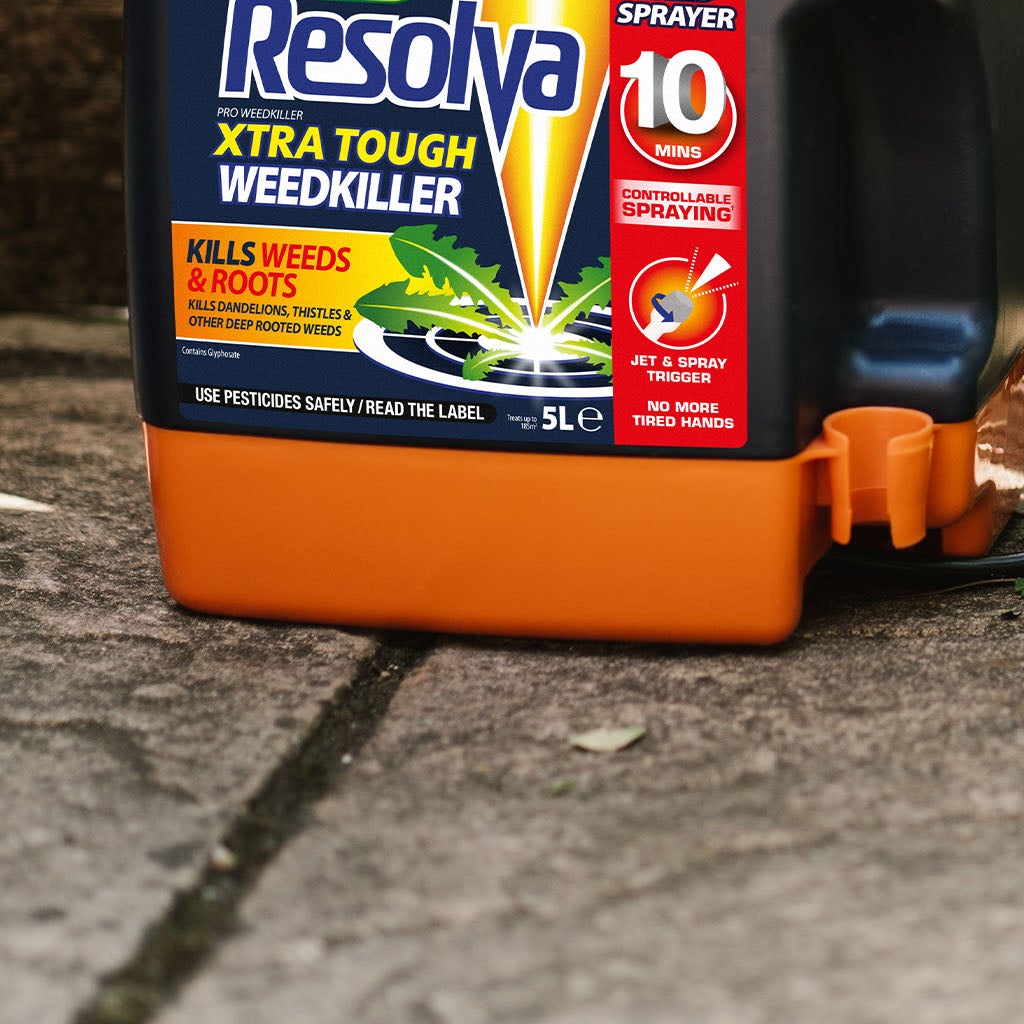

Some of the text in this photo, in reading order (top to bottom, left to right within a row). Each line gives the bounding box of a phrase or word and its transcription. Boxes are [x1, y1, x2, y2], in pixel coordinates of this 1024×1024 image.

[617, 3, 737, 29] SPRAYER
[620, 49, 727, 135] 10
[217, 107, 304, 121] PRO WEEDKILLER
[213, 123, 477, 170] XTRA TOUGH
[655, 143, 702, 159] MINS
[219, 164, 463, 216] WEEDKILLER
[622, 188, 732, 205] CONTROLLABLE
[186, 238, 351, 273] KILLS WEEDS
[187, 267, 298, 299] & ROOTS
[188, 299, 352, 321] KILLS DANDELIONS, THISTLES &
[188, 315, 342, 337] OTHER DEEP ROOTED WEEDS
[181, 346, 241, 359] Contains Glyphosate
[631, 355, 728, 370] JET & SPRAY
[646, 371, 712, 384] TRIGGER
[195, 387, 221, 403] USE
[224, 391, 302, 410] PESTICIDES
[305, 396, 355, 414] SAFELY
[366, 400, 404, 416] READ
[408, 402, 434, 418] THE
[439, 404, 485, 421] LABEL
[647, 401, 719, 414] NO MORE
[506, 413, 538, 423] Treats up to
[541, 405, 575, 431] 5L
[632, 414, 734, 429] TIRED HANDS
